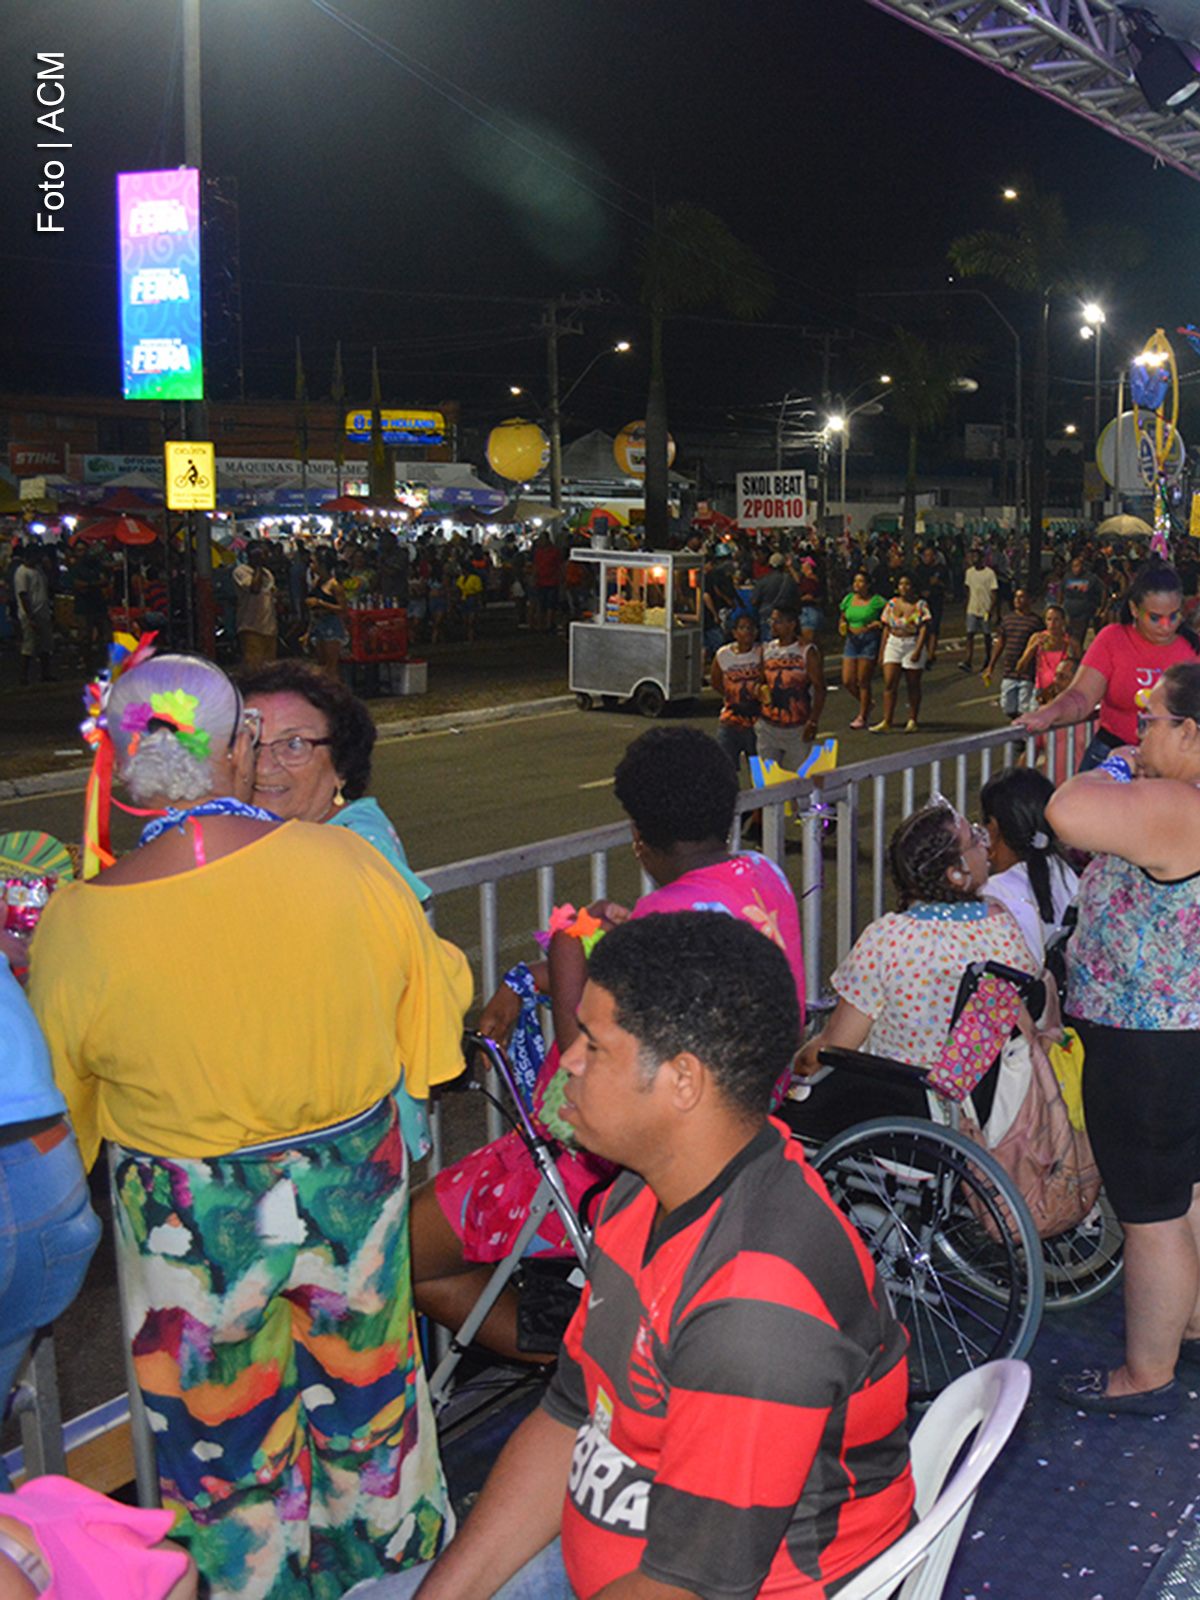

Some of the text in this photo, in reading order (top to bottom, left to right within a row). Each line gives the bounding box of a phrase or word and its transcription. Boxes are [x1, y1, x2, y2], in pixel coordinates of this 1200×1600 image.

[391, 419, 436, 429] HOLLAND
[15, 452, 60, 465] STIHL
[742, 475, 802, 496] SKOL BEAT
[743, 498, 803, 519] 2POR10
